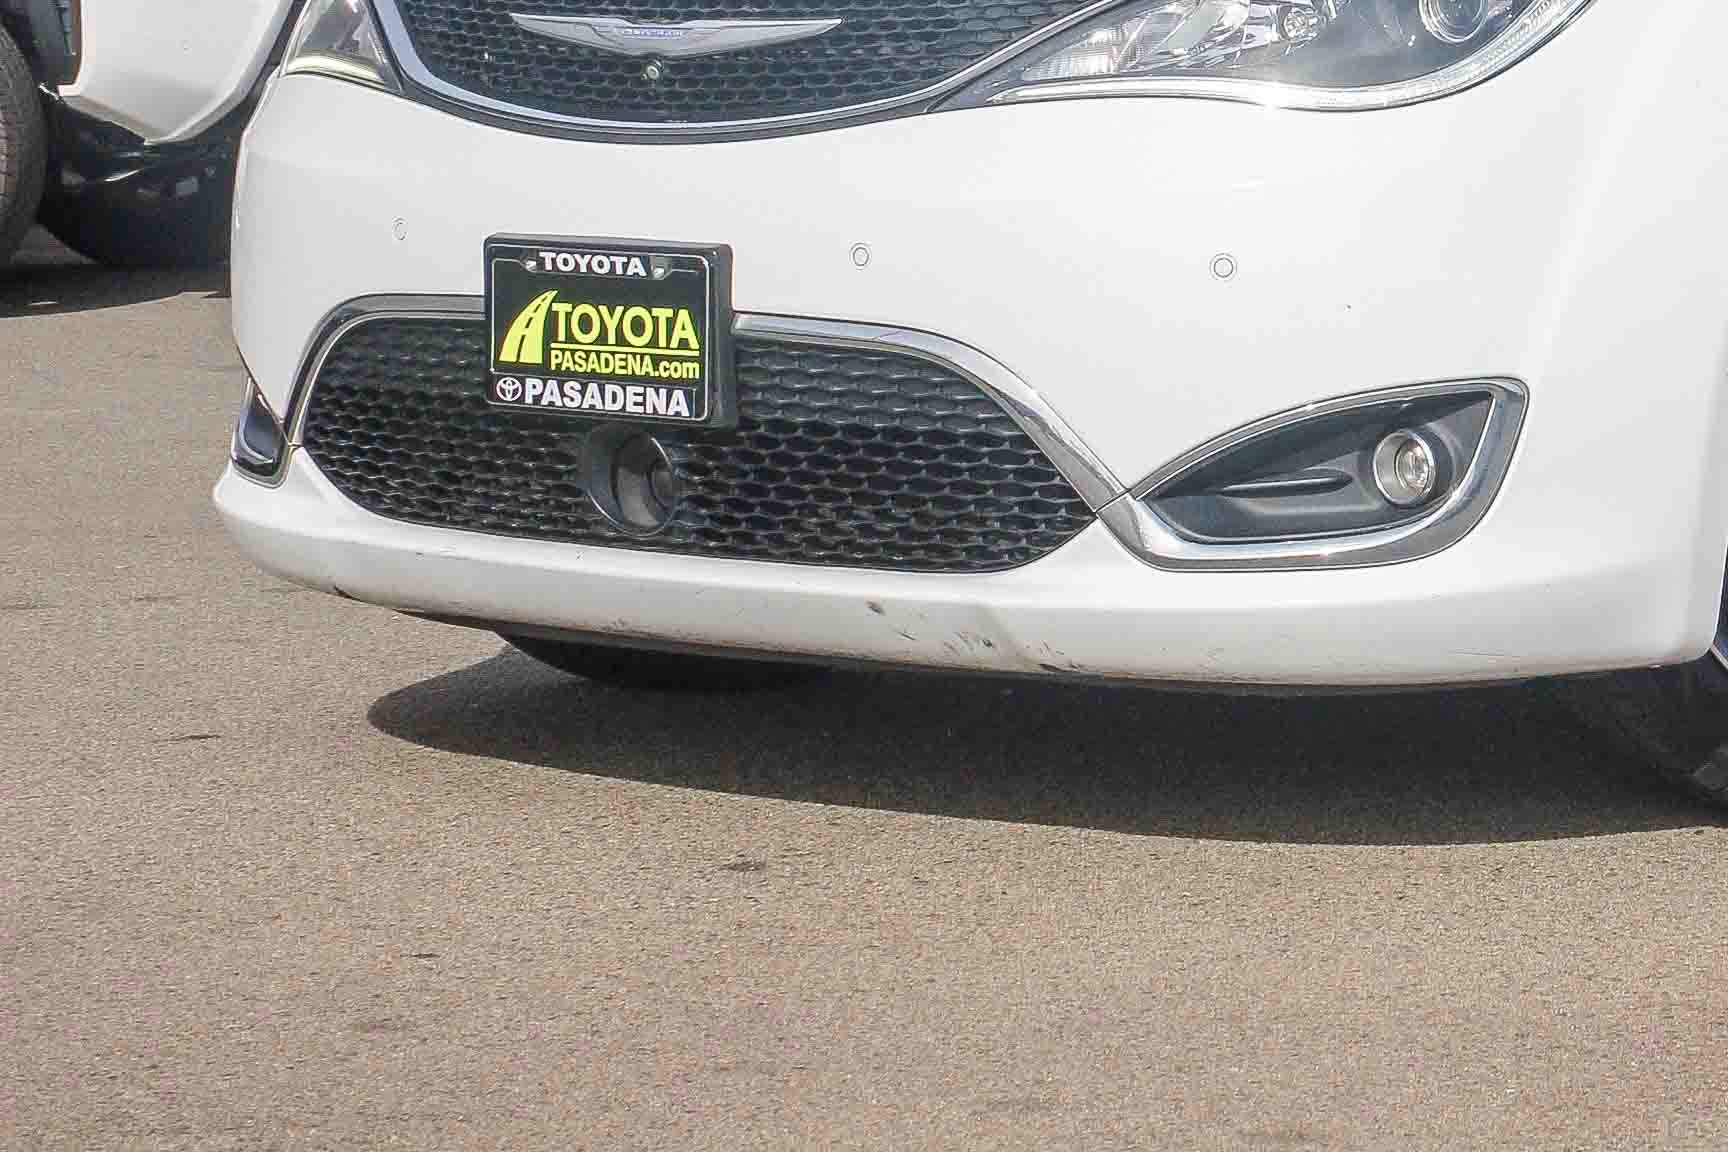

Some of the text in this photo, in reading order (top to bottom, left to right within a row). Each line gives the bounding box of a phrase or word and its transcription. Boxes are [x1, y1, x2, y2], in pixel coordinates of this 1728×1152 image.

[539, 251, 648, 277] TOYOTA
[551, 302, 700, 350] TOYOTA
[550, 350, 700, 379] PASADENA.com
[524, 377, 690, 417] PASADENA
